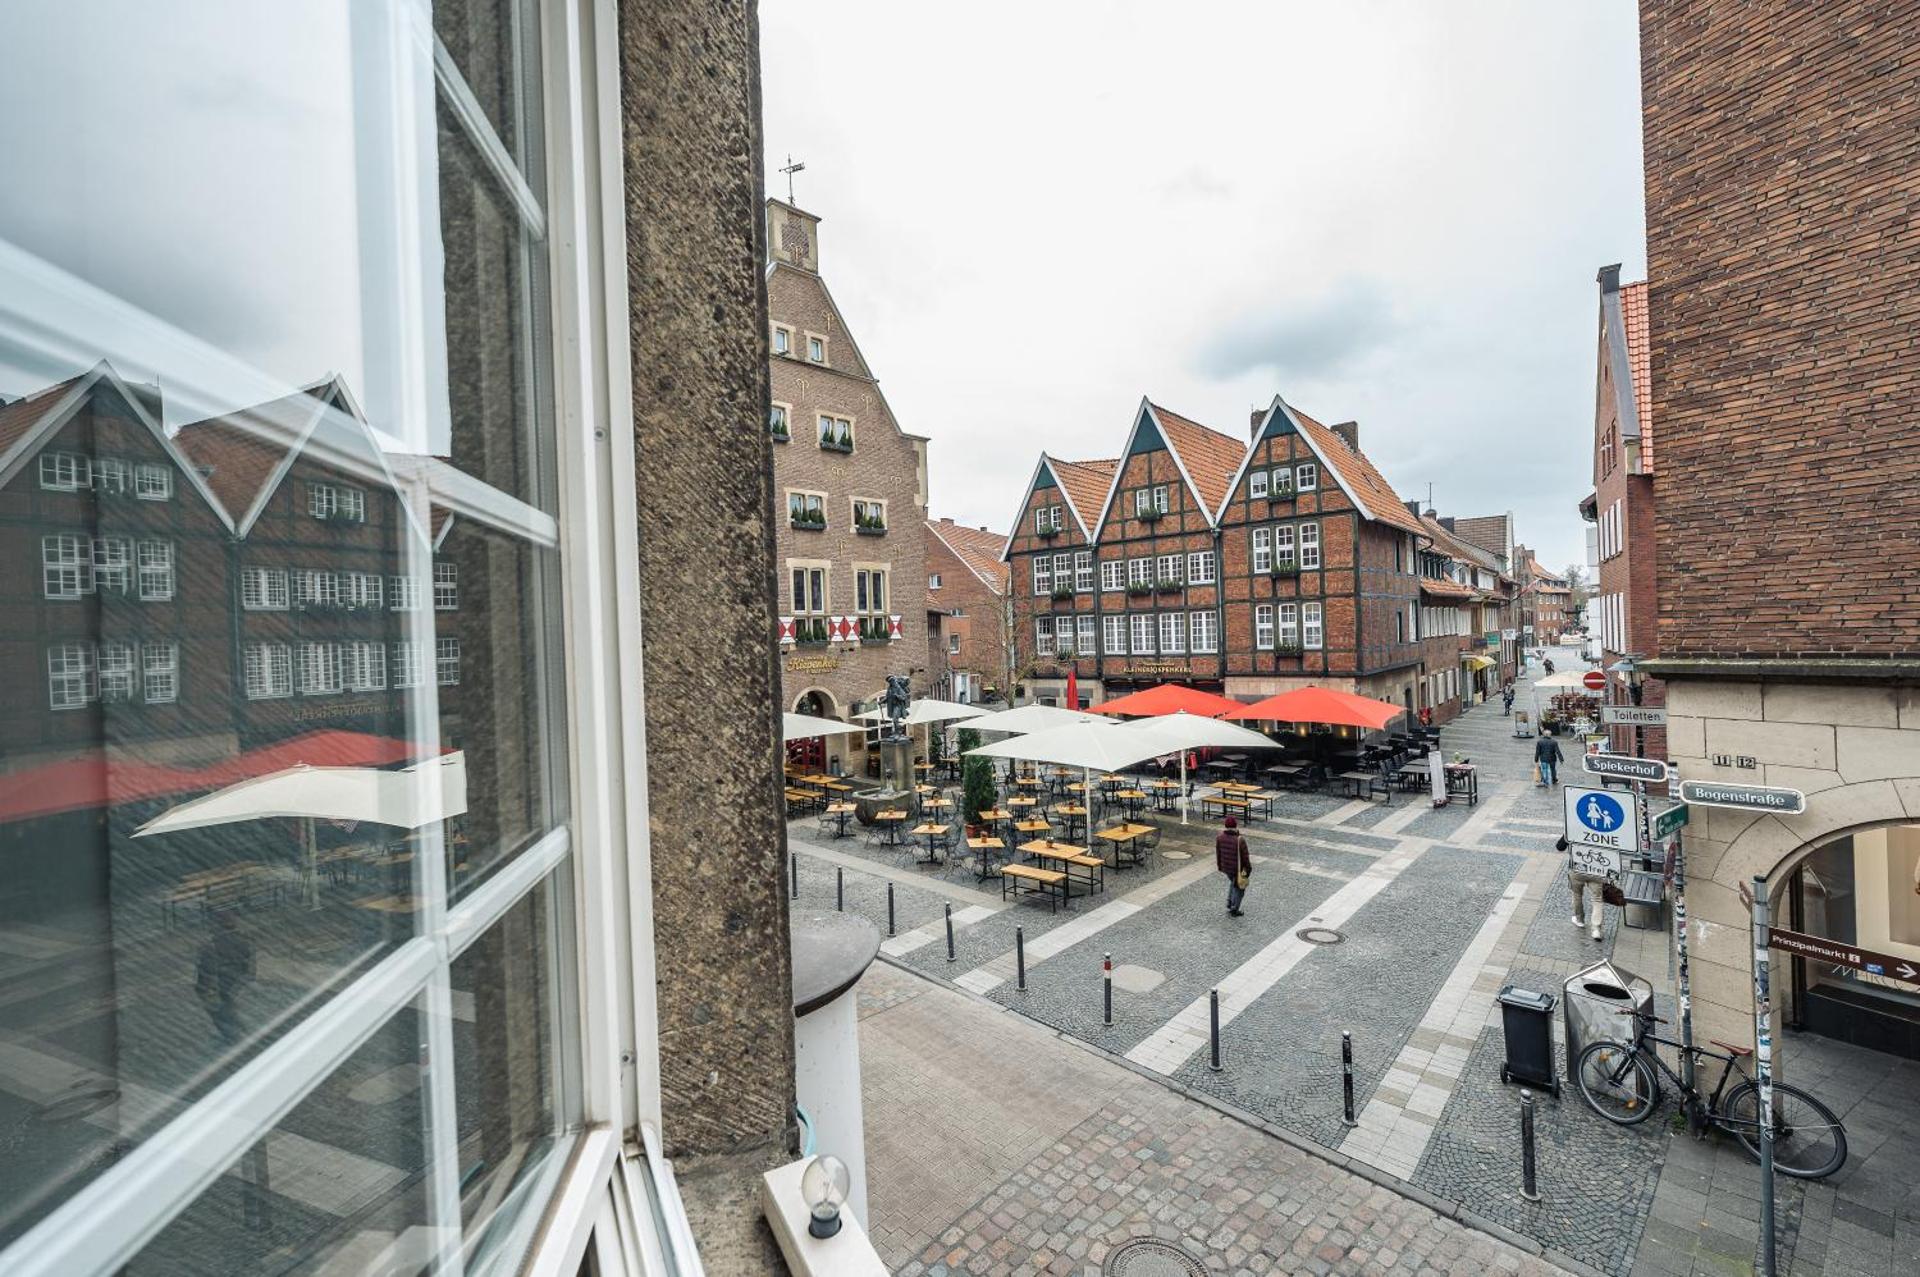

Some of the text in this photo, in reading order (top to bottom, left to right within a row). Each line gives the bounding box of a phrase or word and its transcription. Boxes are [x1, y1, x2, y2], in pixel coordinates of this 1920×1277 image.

[1613, 709, 1661, 721] Toiletten
[1594, 760, 1657, 776] Spiekerhof
[1716, 755, 1727, 765] 11
[1739, 758, 1753, 768] 12
[1695, 787, 1785, 806] Bogenstraße
[1583, 831, 1619, 847] ZONE
[1772, 934, 1846, 960] Prinzipalmarkt
